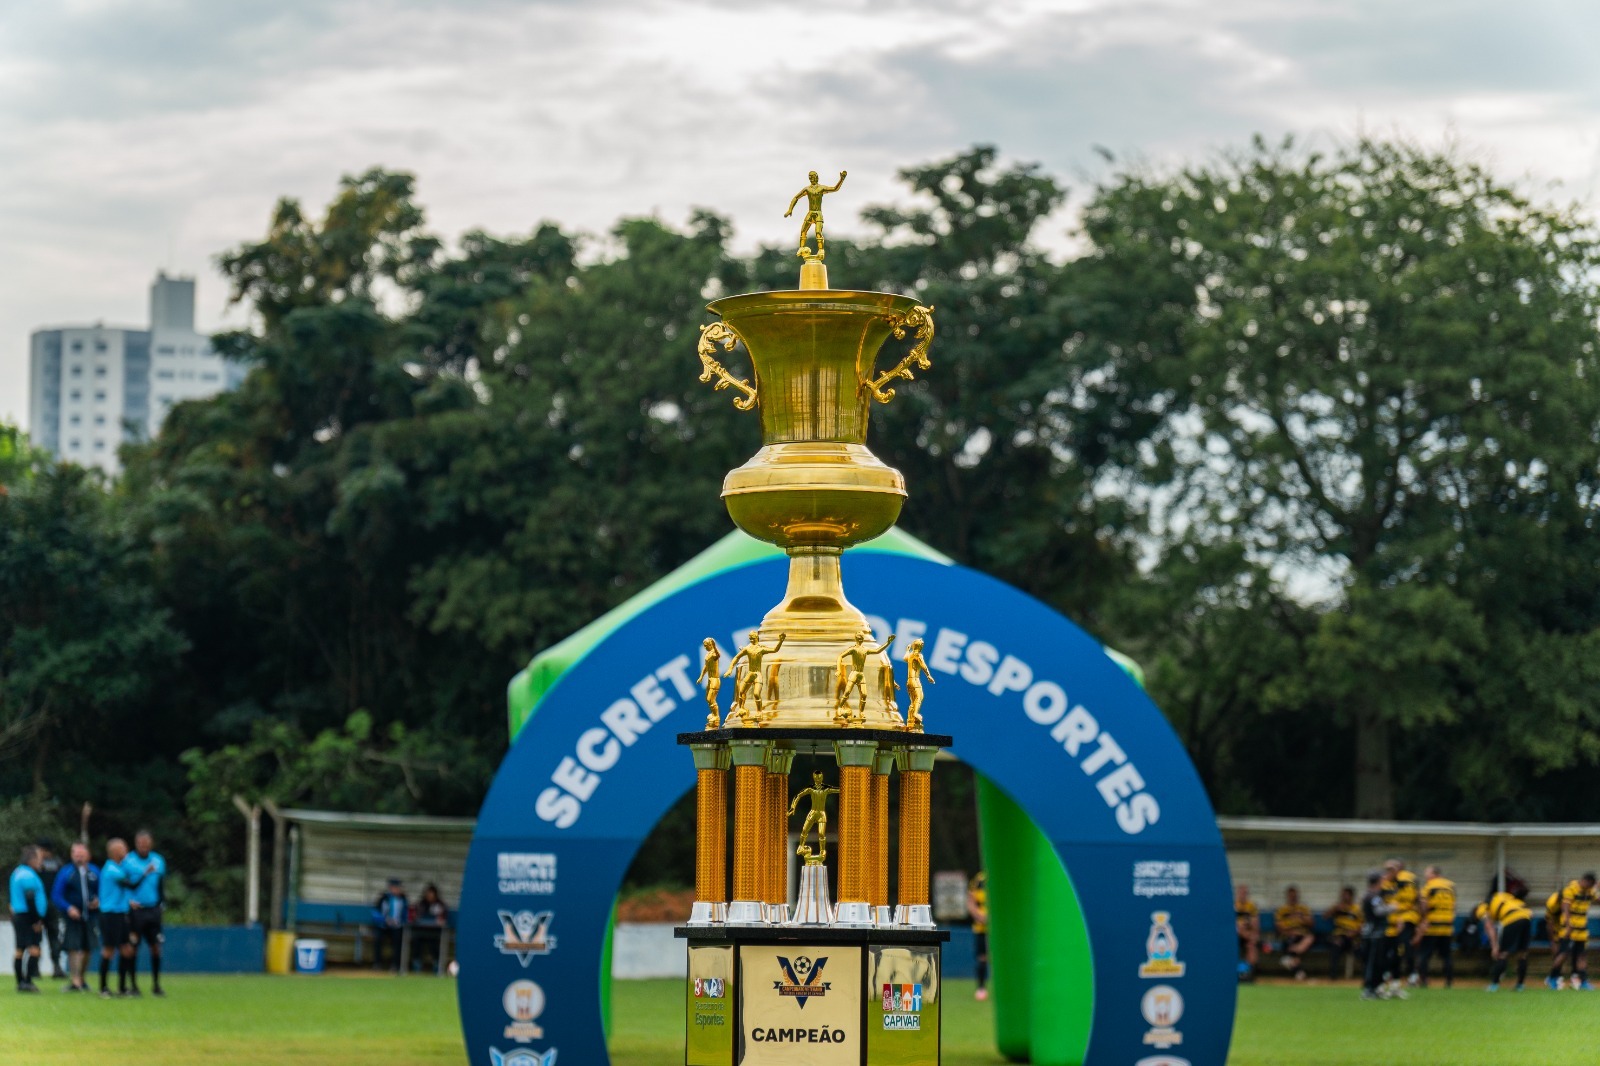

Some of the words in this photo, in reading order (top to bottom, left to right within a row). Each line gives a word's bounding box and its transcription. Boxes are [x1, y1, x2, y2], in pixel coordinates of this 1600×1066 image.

[535, 626, 758, 829] SECRETA
[929, 627, 1160, 834] ESPORTES
[695, 1012, 724, 1029] Esportes
[884, 1015, 920, 1027] CAPIVARI
[751, 1024, 846, 1043] CAMPEÃO
